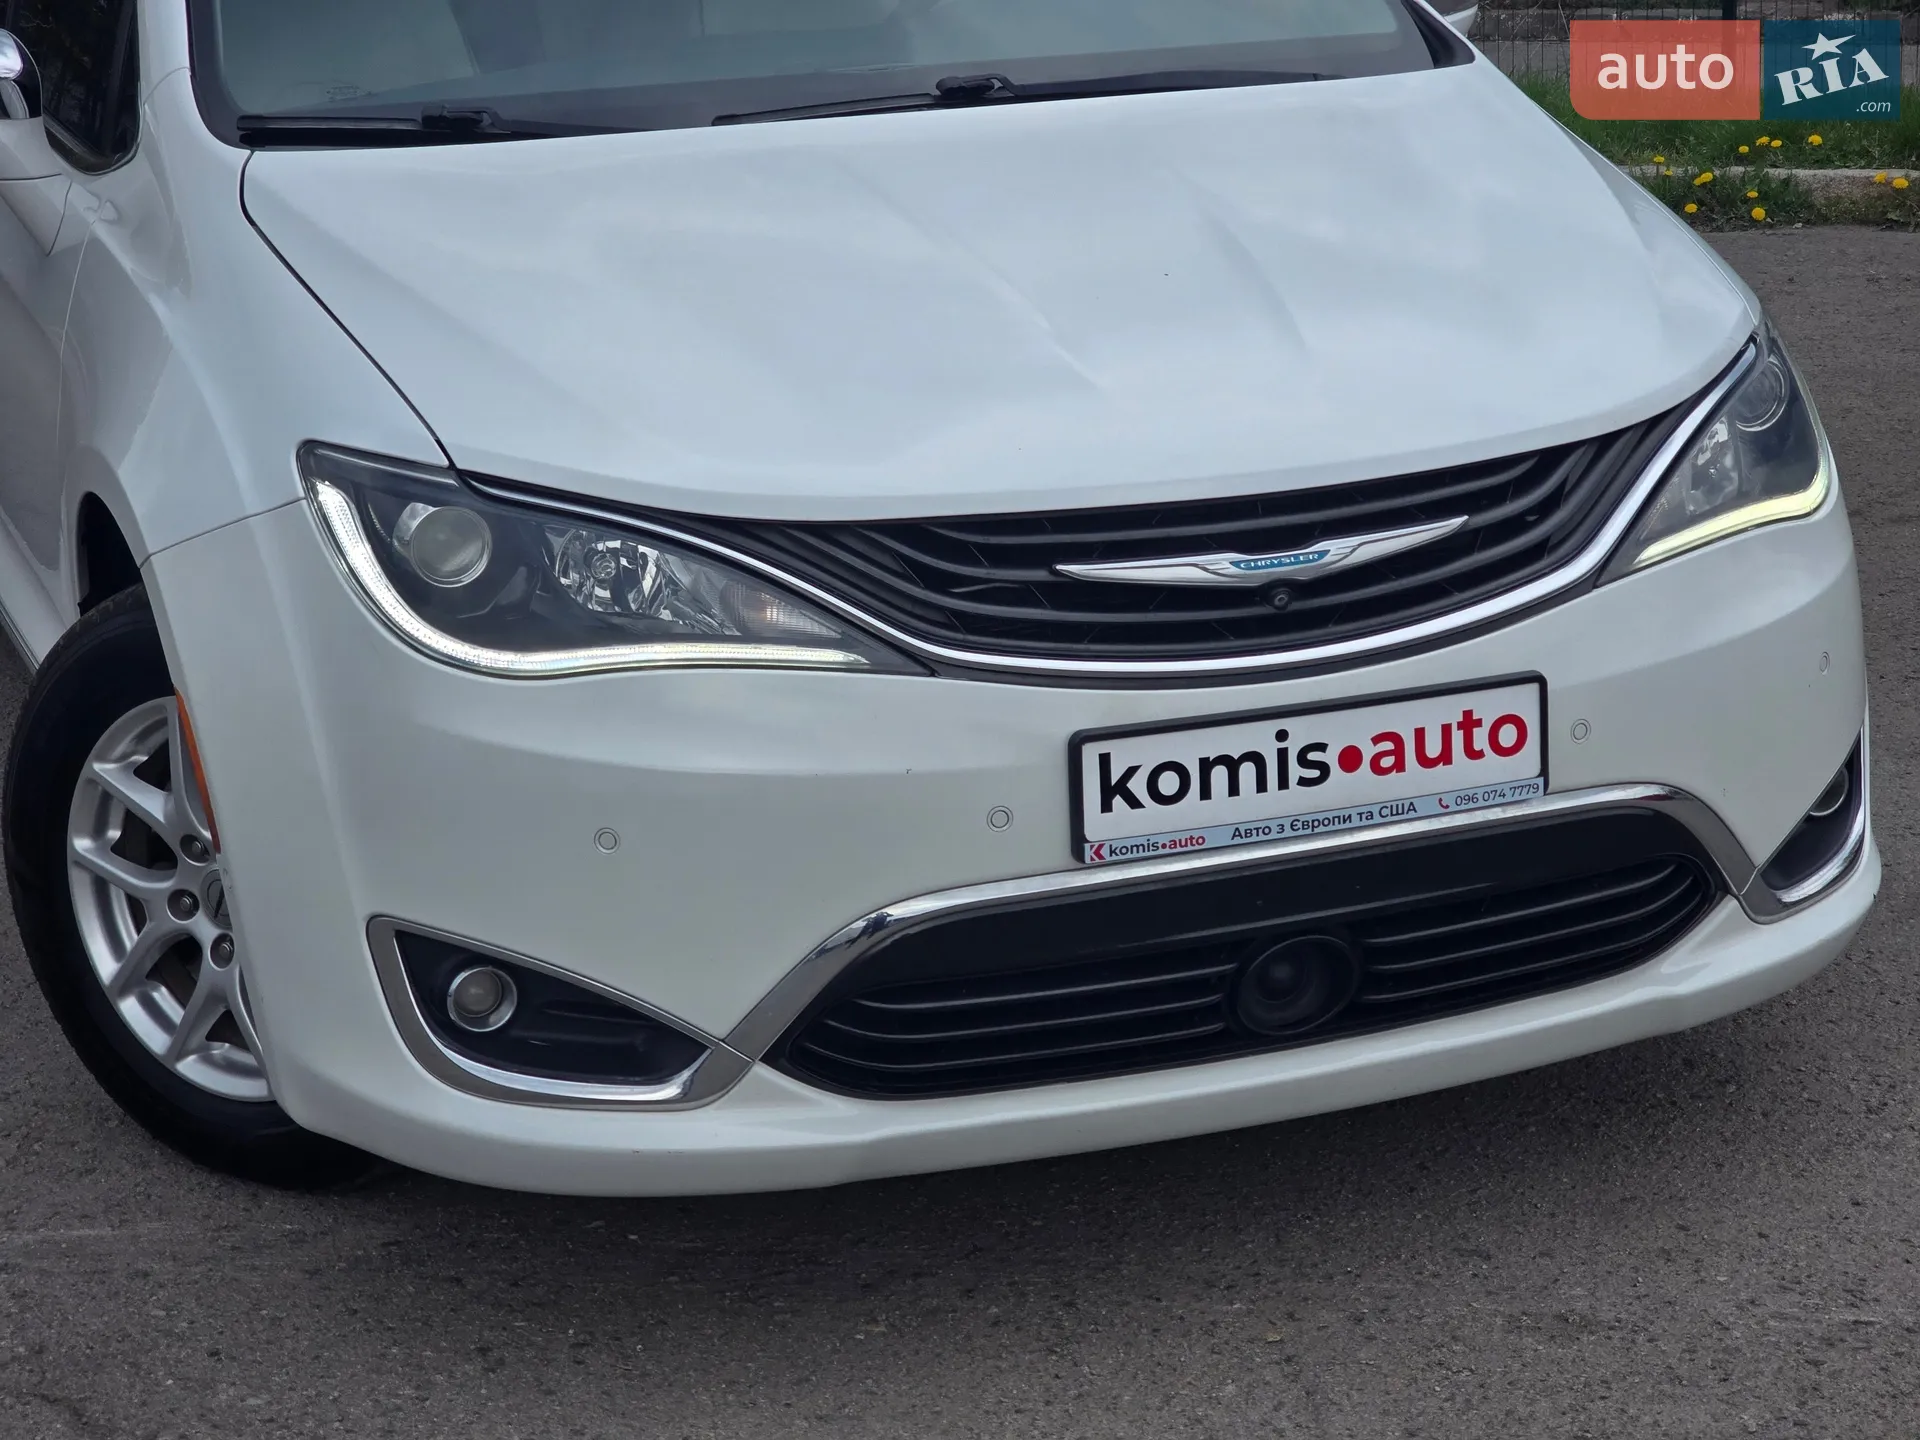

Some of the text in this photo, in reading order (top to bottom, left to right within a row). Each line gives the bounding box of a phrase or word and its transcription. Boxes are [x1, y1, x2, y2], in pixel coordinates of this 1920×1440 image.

[1240, 553, 1319, 569] CHRYSLER
[1454, 782, 1540, 807] 096 074 7779
[1230, 801, 1418, 841] Авто з Європи та США
